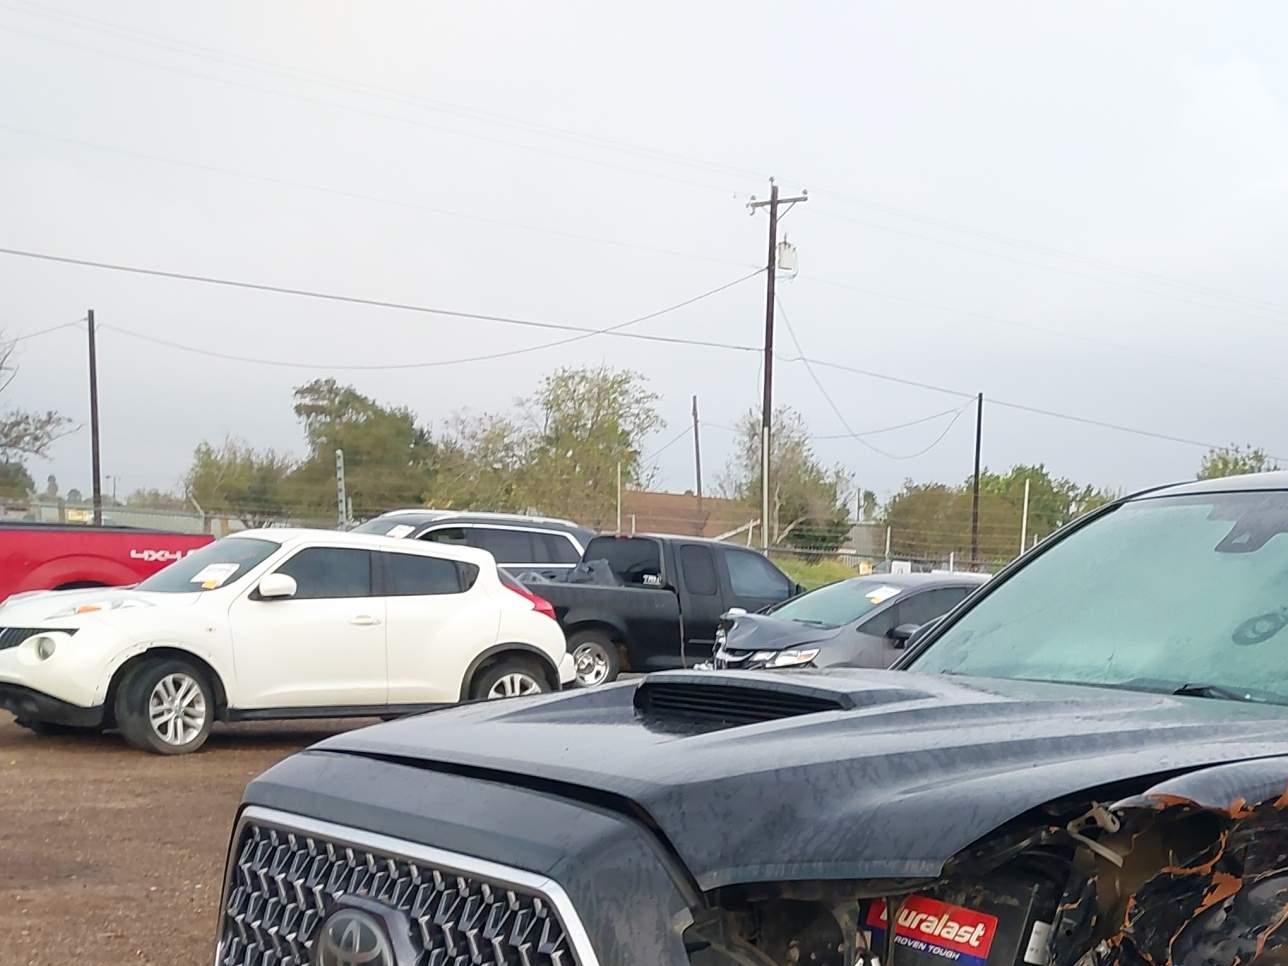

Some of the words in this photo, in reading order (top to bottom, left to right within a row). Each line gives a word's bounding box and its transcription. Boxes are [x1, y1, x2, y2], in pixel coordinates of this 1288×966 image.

[879, 906, 986, 948] uralast
[893, 935, 928, 951] ROVEN
[927, 943, 962, 962] TOUGH
